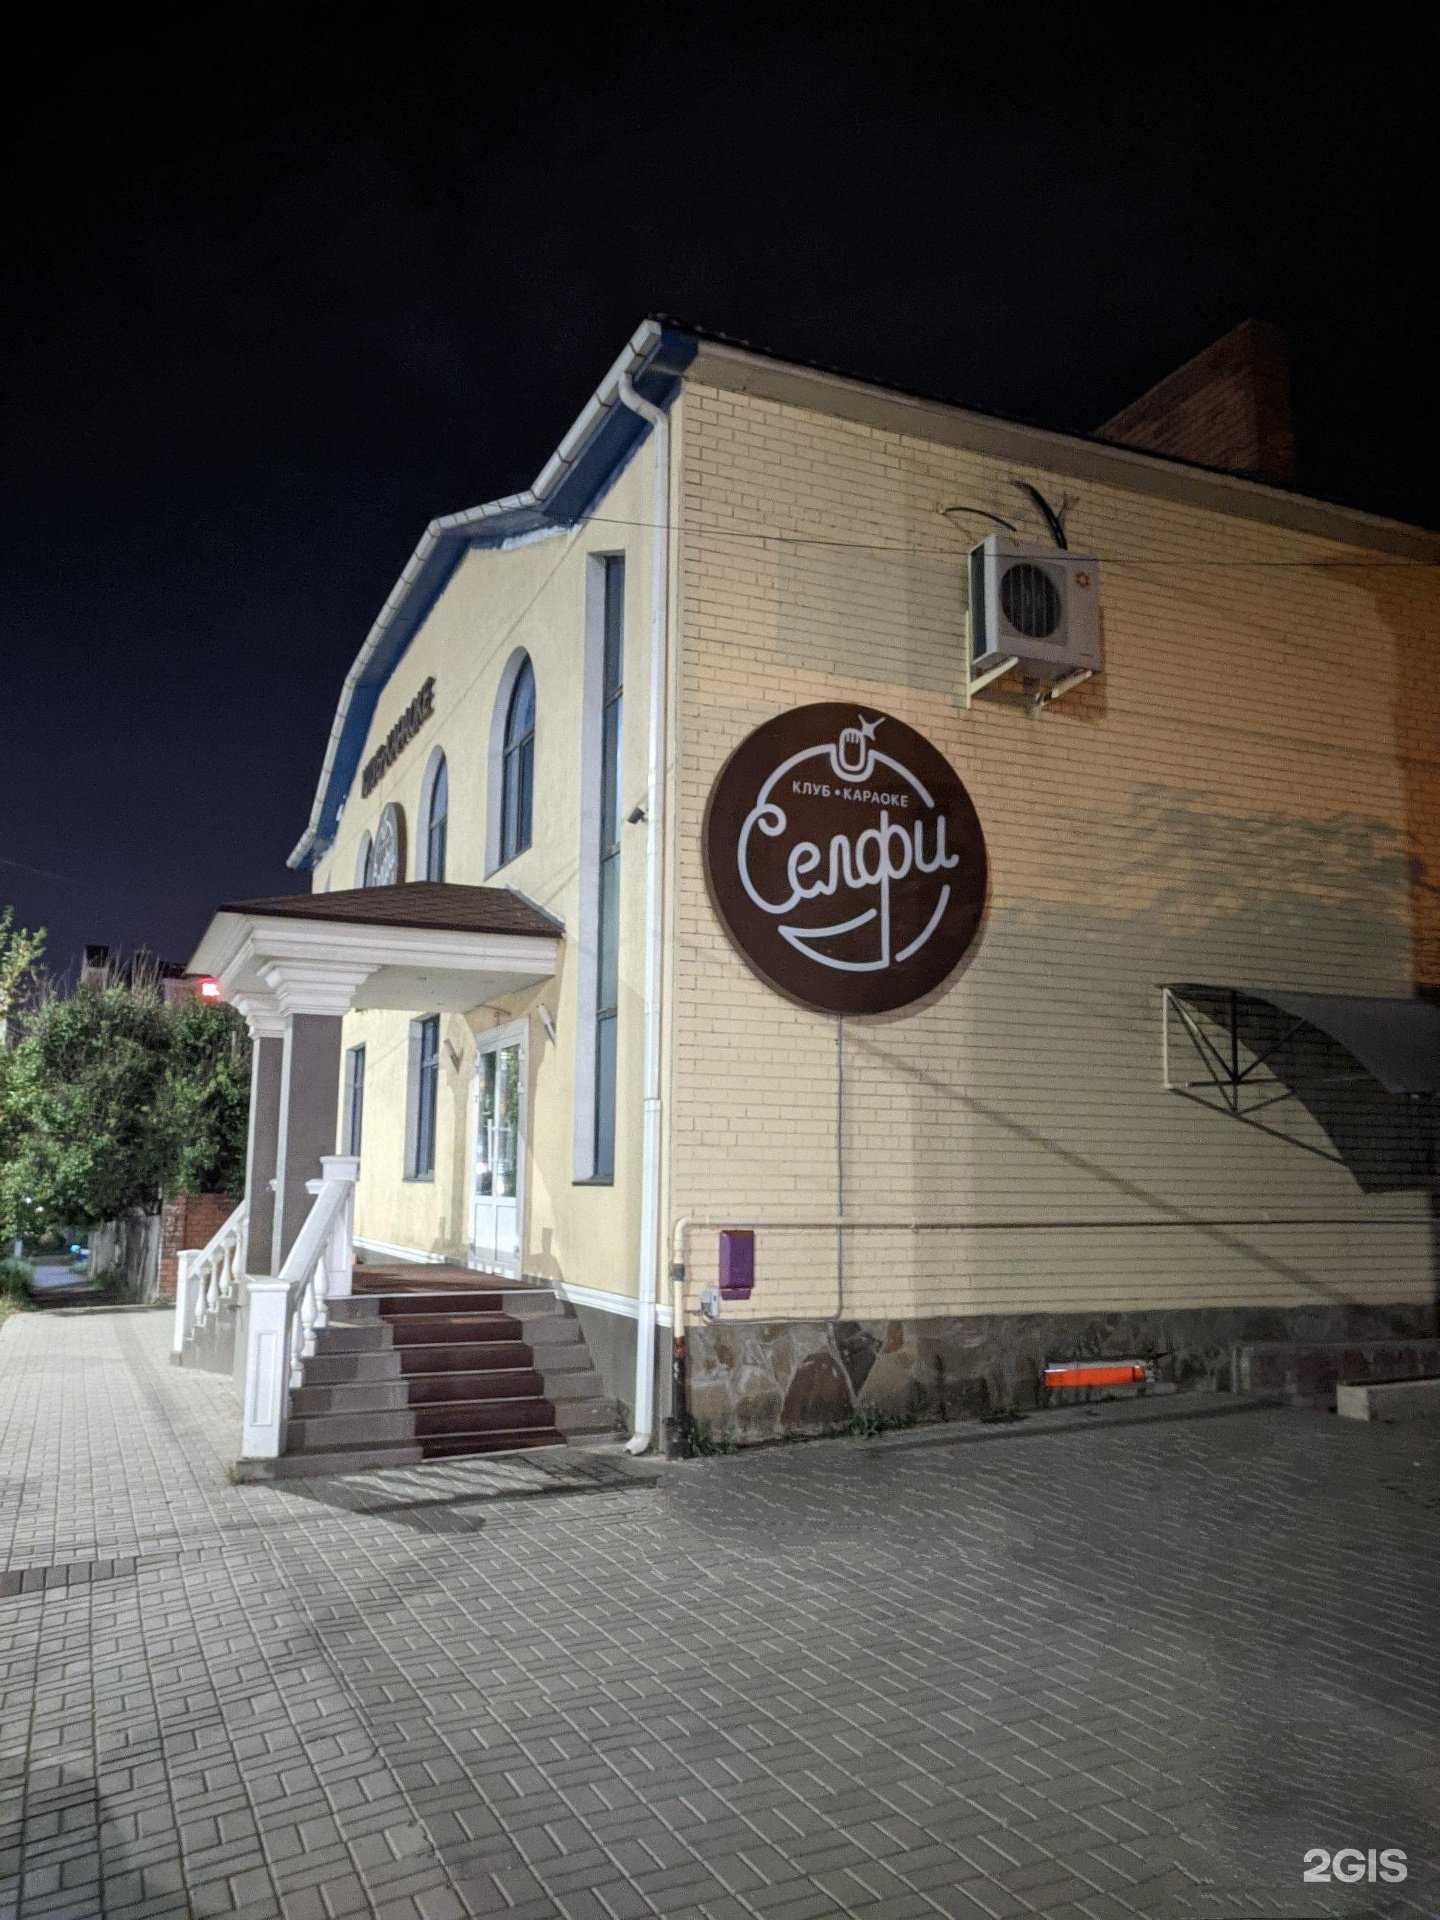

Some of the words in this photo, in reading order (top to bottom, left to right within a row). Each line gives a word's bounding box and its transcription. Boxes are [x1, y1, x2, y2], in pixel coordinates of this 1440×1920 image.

[792, 780, 831, 798] КЛУБ
[843, 788, 910, 808] КАРАОКЕ
[737, 803, 959, 966] Селфи
